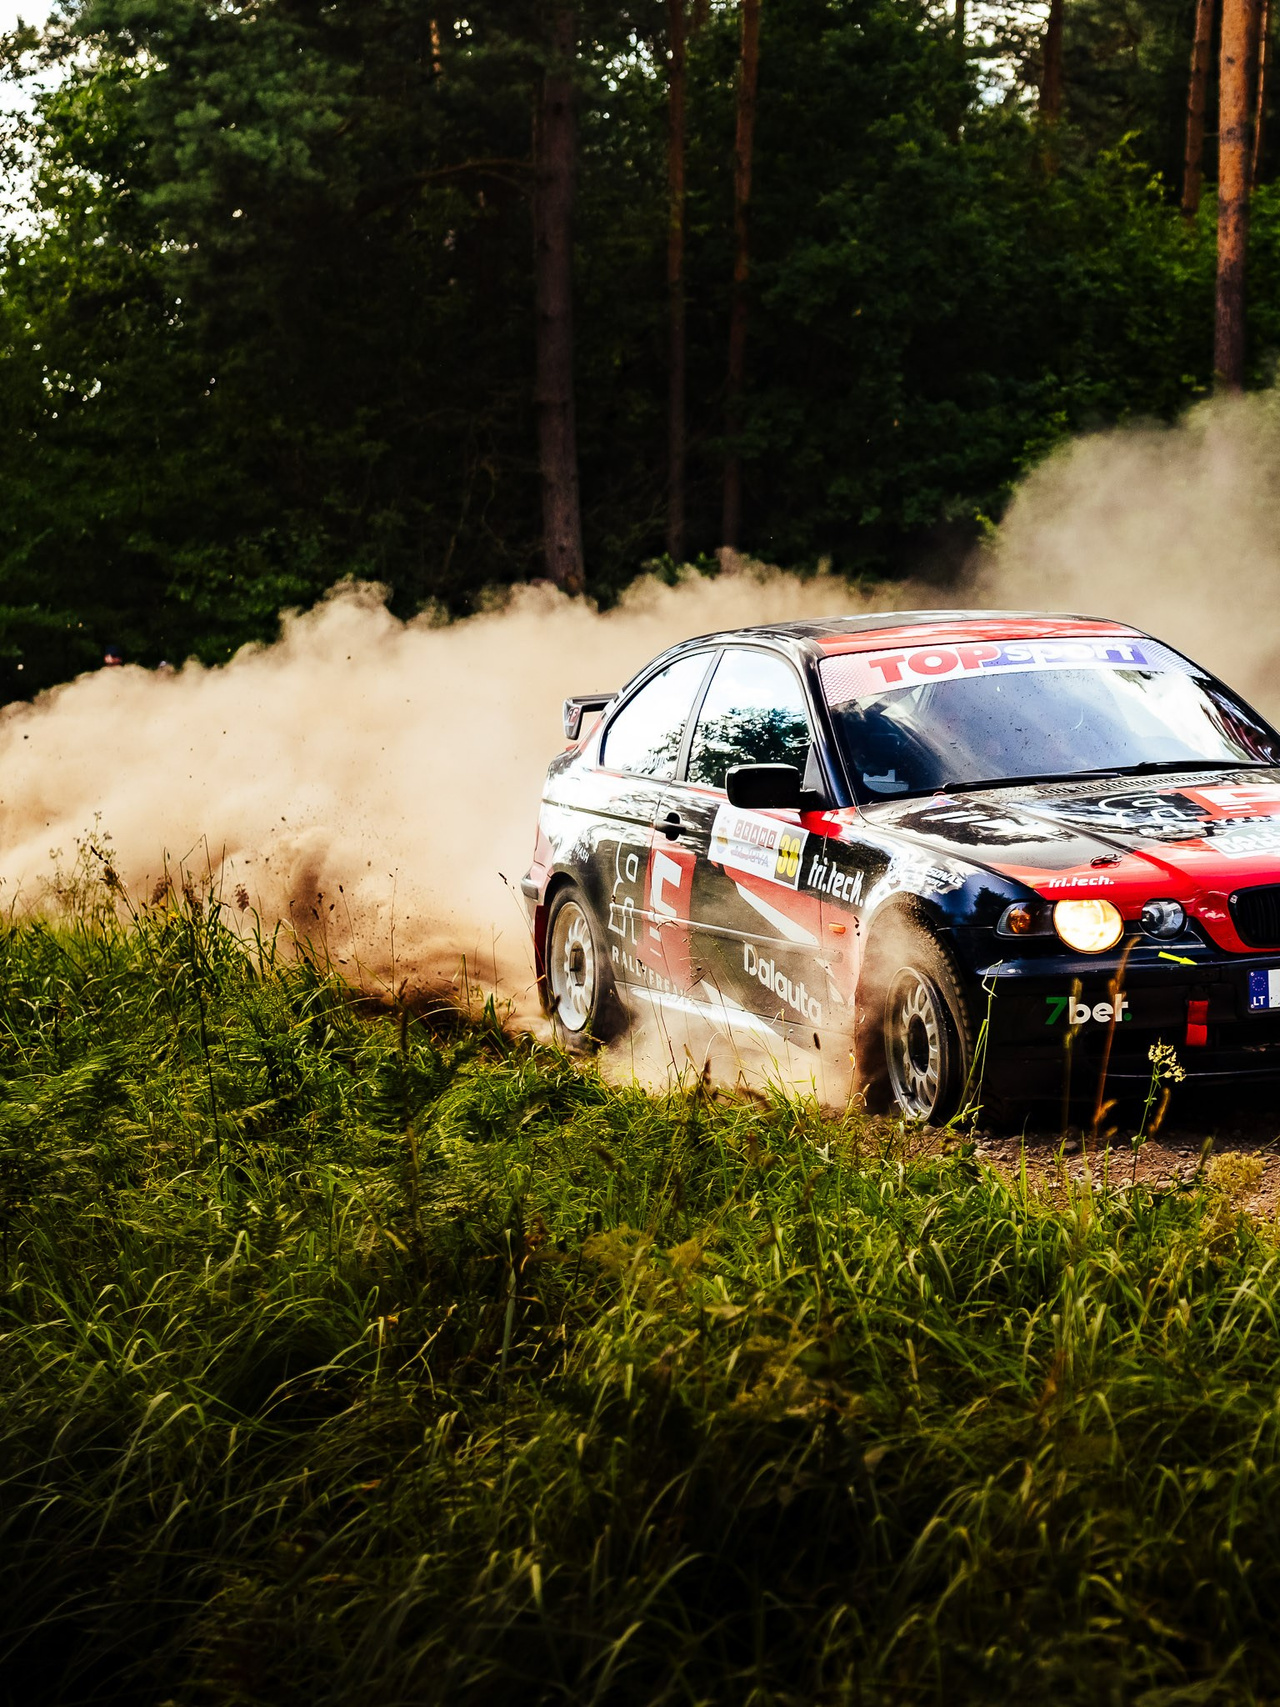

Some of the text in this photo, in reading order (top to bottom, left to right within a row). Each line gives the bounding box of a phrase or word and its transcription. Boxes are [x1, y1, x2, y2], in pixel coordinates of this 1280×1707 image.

[1048, 875, 1115, 889] fri.tech.
[743, 941, 822, 1028] Dalauta
[1253, 995, 1266, 1006] LT
